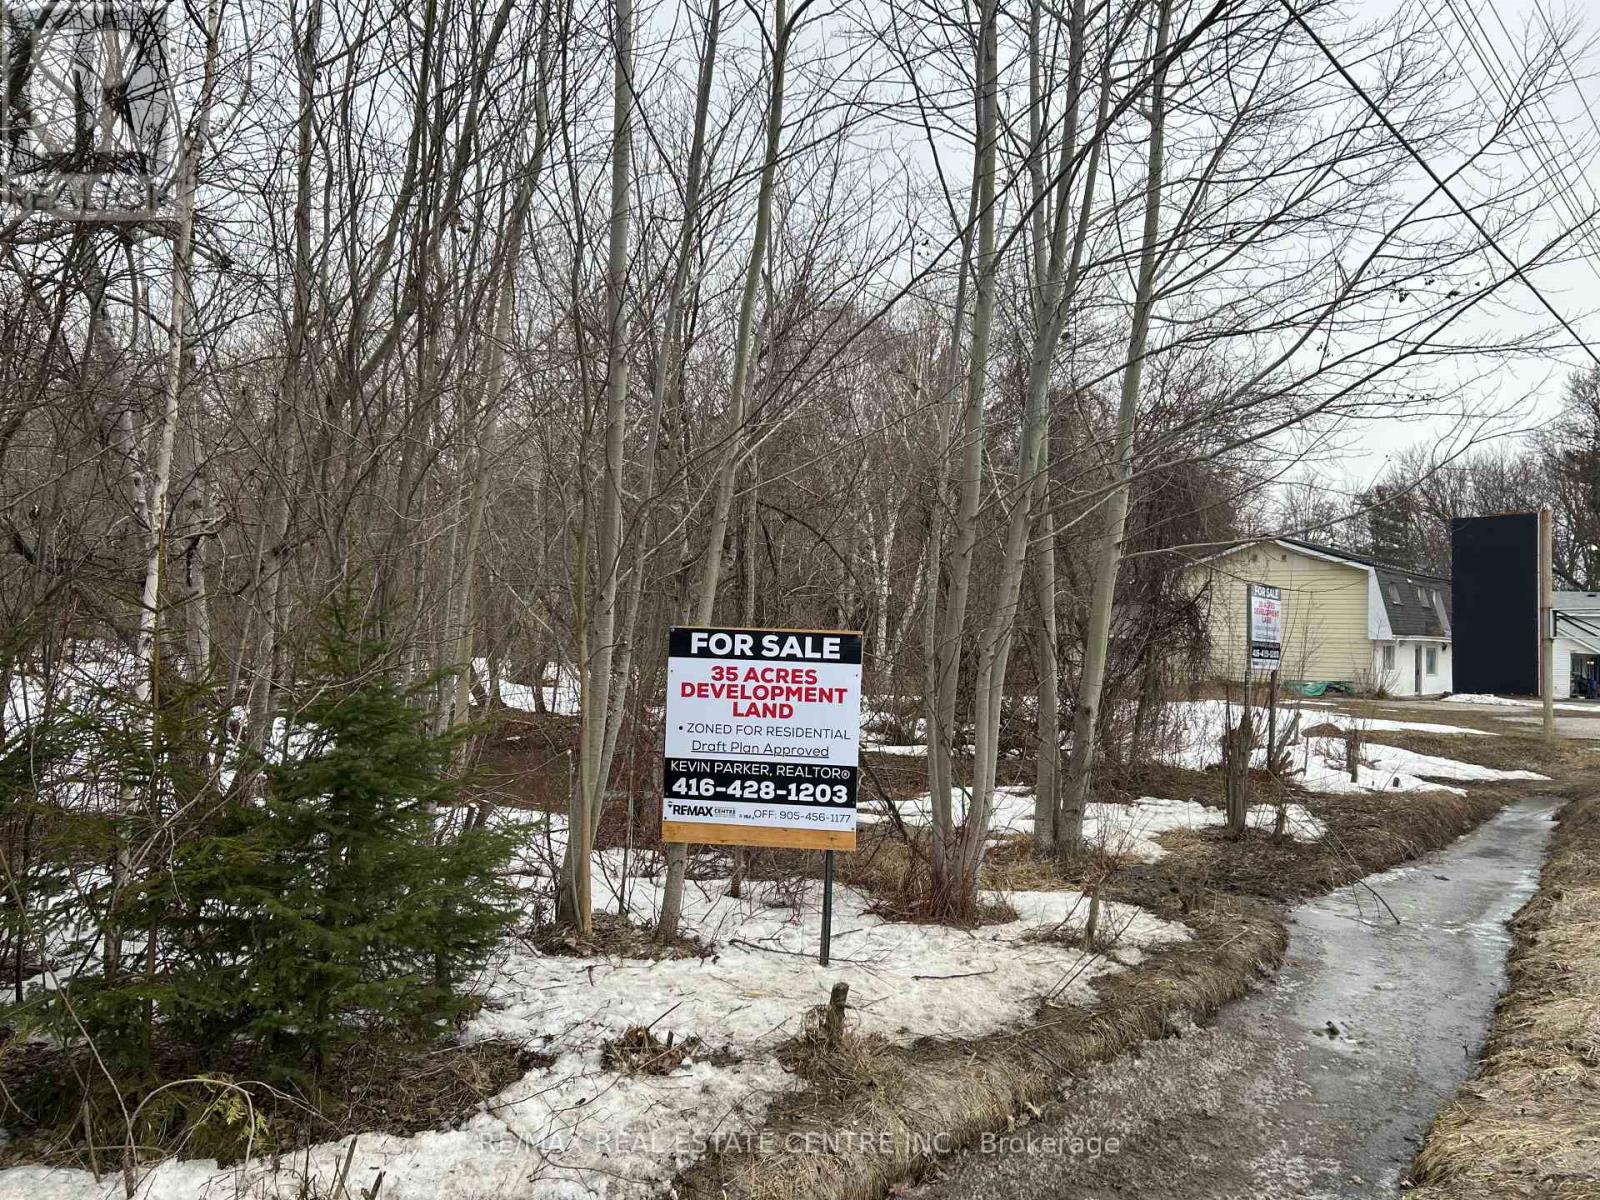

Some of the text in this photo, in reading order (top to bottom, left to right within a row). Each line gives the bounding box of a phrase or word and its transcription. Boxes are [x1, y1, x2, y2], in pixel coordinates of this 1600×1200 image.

[690, 632, 841, 660] FOR SALE
[711, 665, 818, 685] 35 ACRES
[681, 682, 848, 704] DEVELOPMENT
[732, 702, 794, 719] LAND
[687, 722, 851, 740] ZONED FOR RESIDENTIAL
[692, 740, 830, 758] Draft Plan Approved
[671, 761, 711, 773] KEVIN
[672, 777, 848, 803] 416-428-1203
[753, 809, 777, 819] OFF:
[780, 810, 851, 823] 905-456-1177
